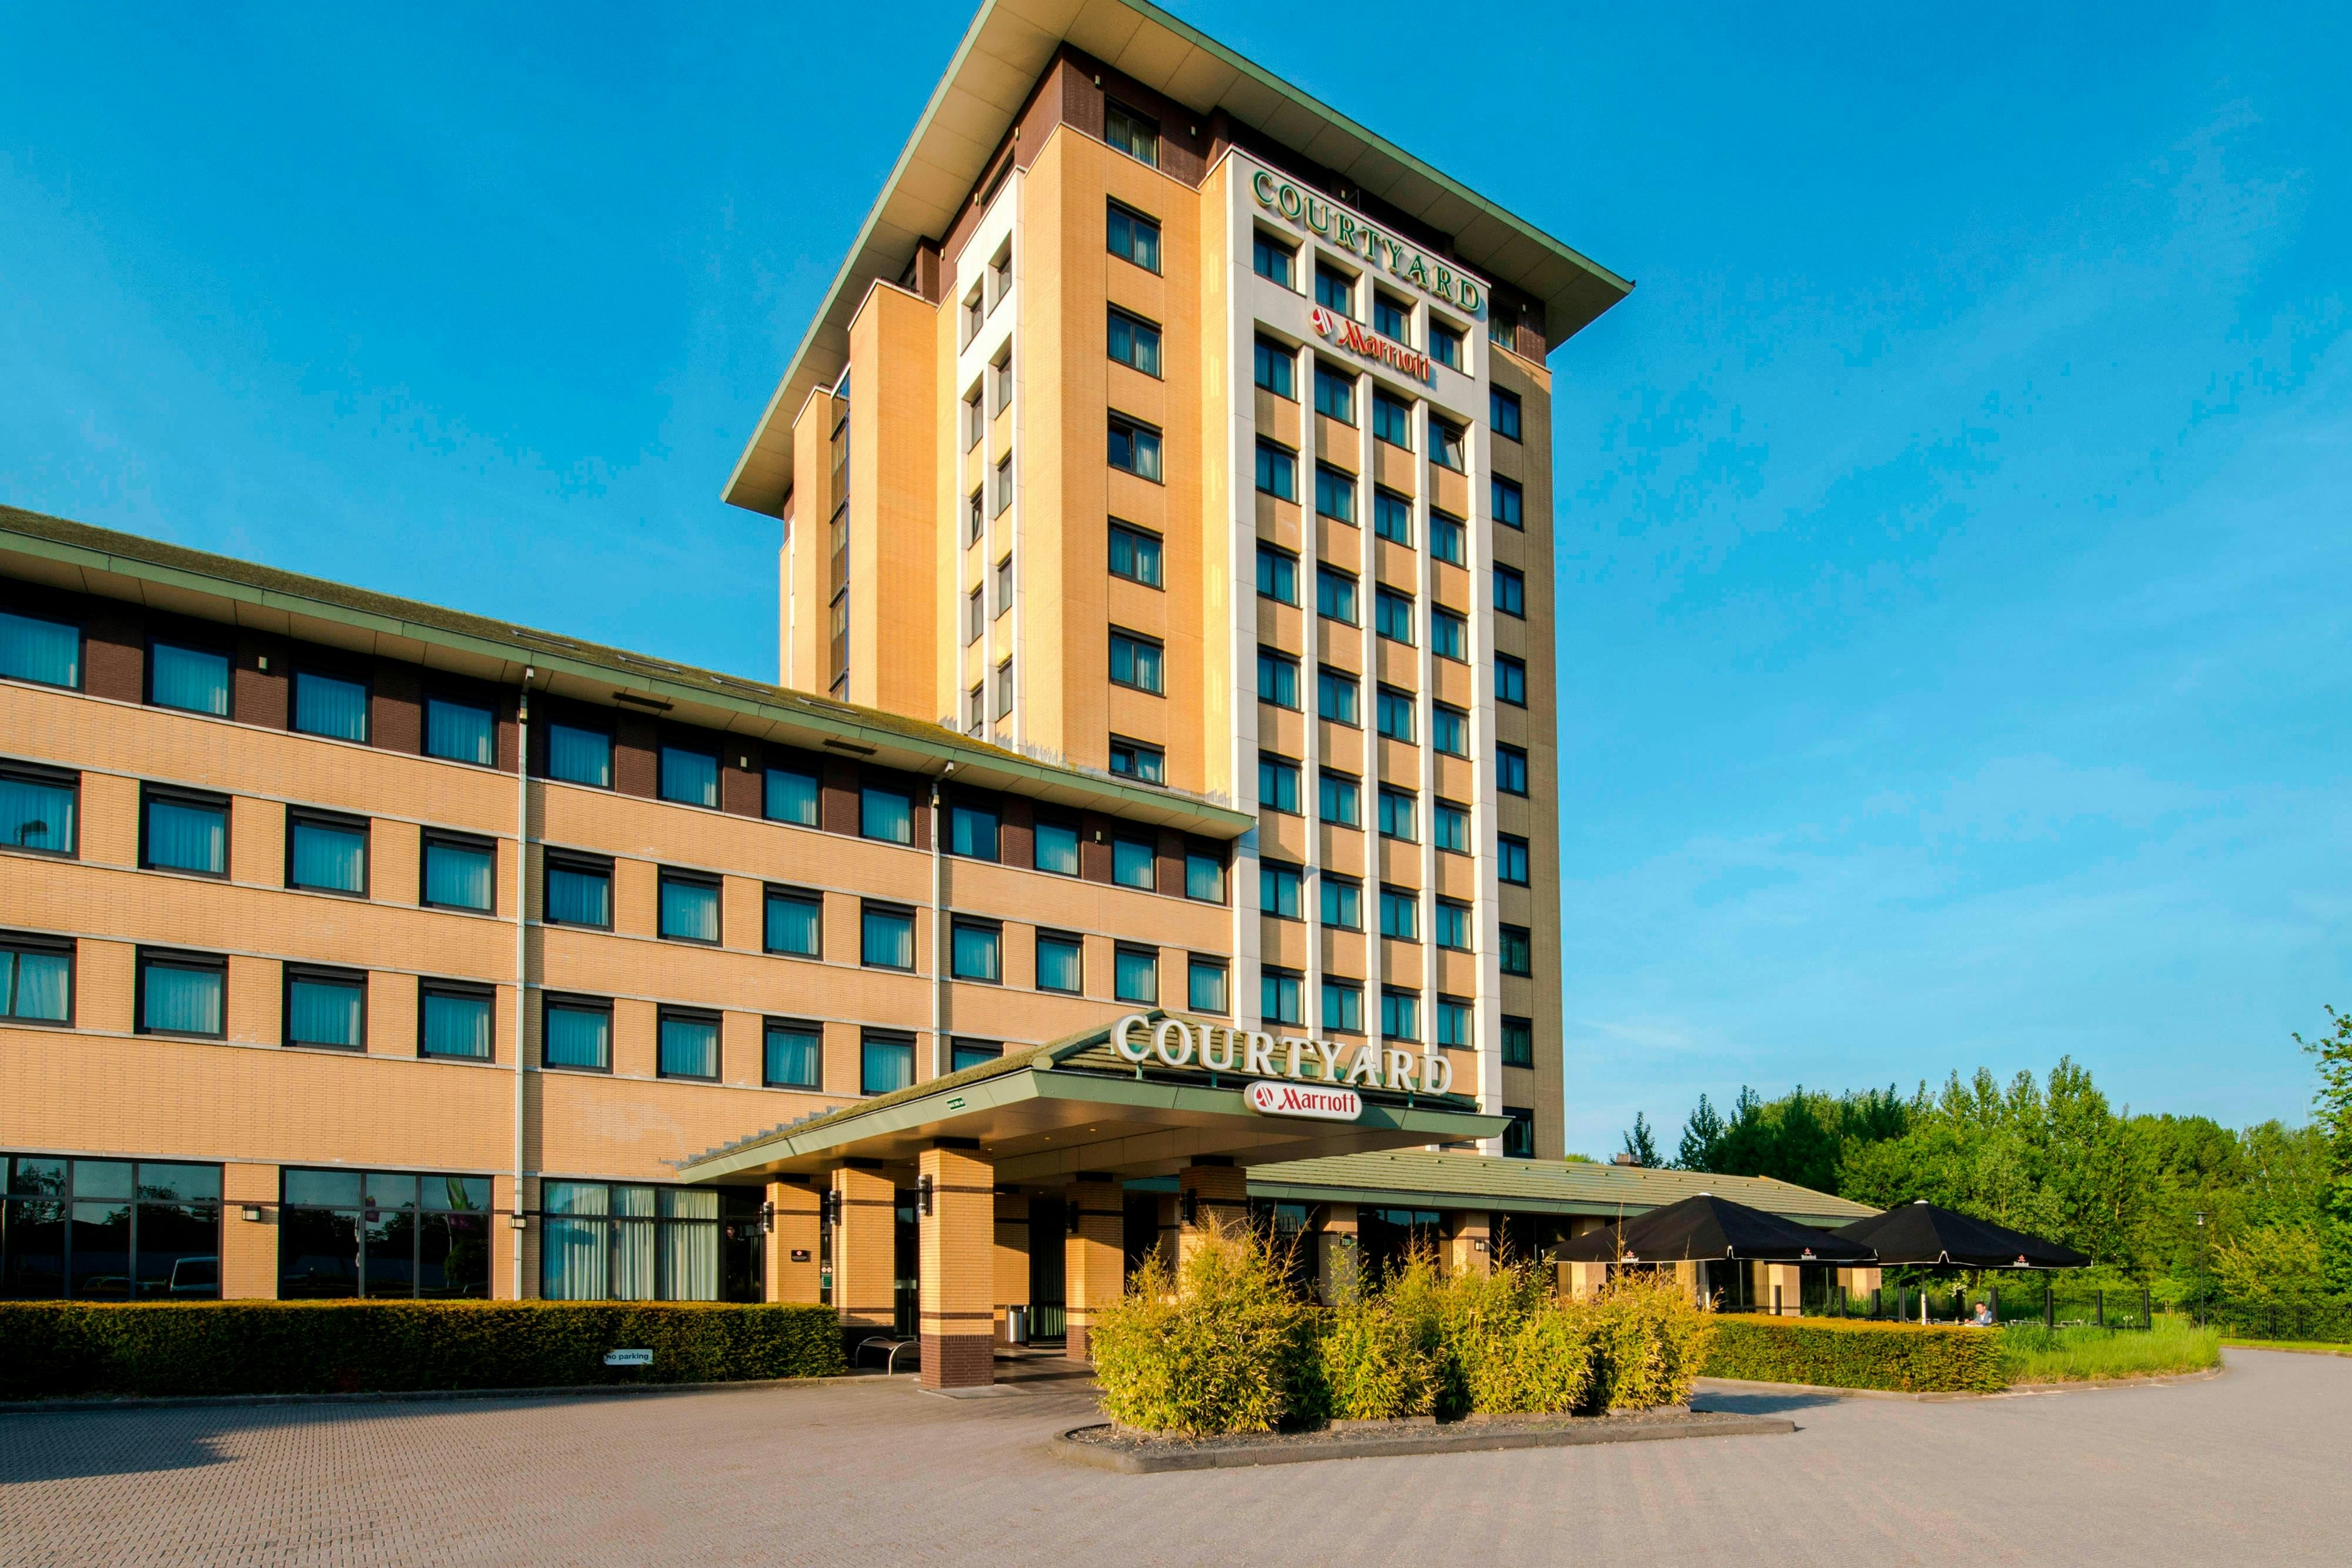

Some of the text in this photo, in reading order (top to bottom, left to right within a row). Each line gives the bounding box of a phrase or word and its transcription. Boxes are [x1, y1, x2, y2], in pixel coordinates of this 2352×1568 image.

[1251, 170, 1481, 313] COURTYARD
[1335, 320, 1429, 381] Marriott
[1110, 1014, 1454, 1095] COURTYARD
[1277, 1087, 1355, 1113] Marriott
